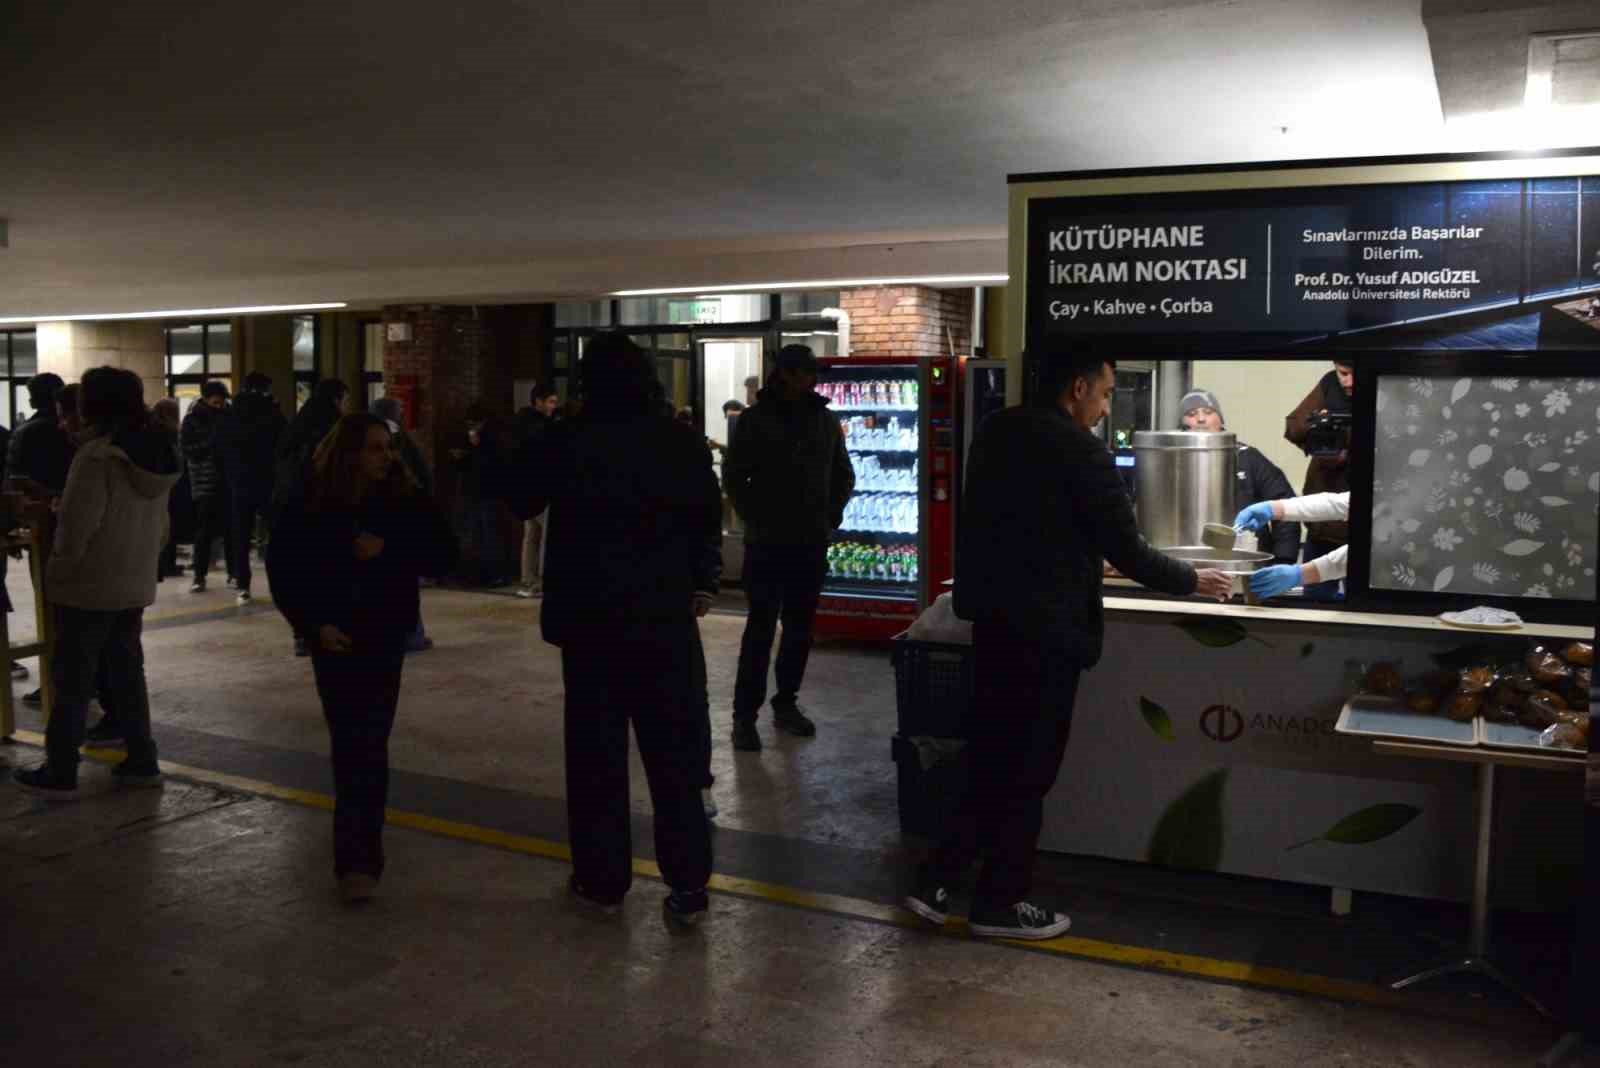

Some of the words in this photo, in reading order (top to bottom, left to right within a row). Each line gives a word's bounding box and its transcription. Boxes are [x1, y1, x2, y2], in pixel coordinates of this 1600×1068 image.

[1049, 224, 1205, 251] KÜTÜPHANE
[1303, 228, 1407, 243] Sınavlarınızda
[1411, 225, 1484, 241] Başarılar
[1363, 246, 1424, 260] Dilerim.
[1049, 259, 1128, 284] İKRAM
[1135, 258, 1247, 282] NOKTASI
[1295, 272, 1329, 286] Prof.
[1332, 272, 1353, 285] Dr.
[1356, 271, 1399, 285] Yusuf
[1400, 268, 1480, 285] ADIGÜZEL
[1303, 289, 1349, 300] Anadolu
[1352, 287, 1420, 300] Üniversitesi
[1423, 287, 1470, 299] Rektörü
[1049, 300, 1080, 320] Çay
[1094, 299, 1146, 315] Kahve
[1160, 297, 1213, 318] Çorba
